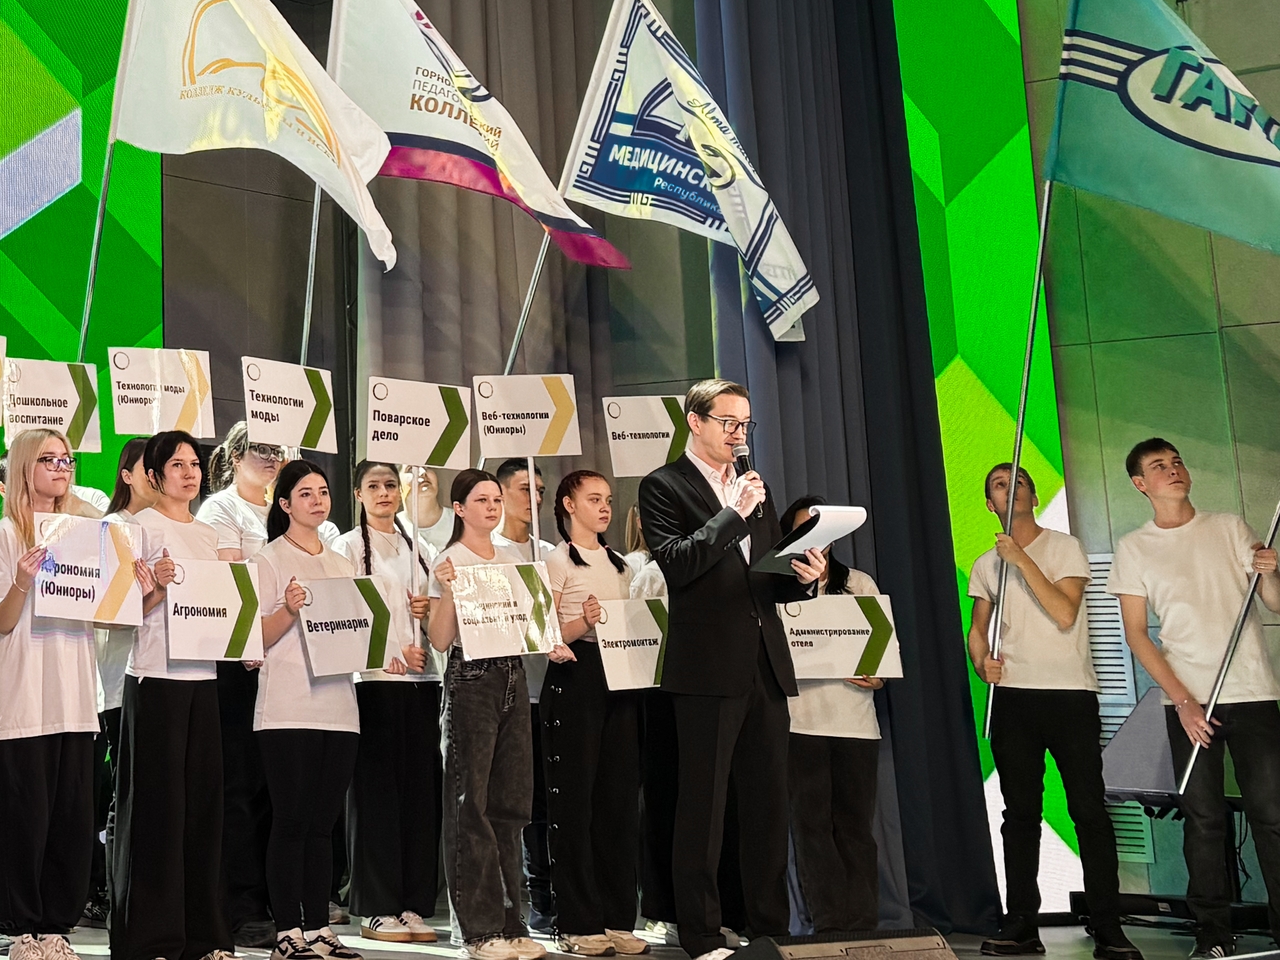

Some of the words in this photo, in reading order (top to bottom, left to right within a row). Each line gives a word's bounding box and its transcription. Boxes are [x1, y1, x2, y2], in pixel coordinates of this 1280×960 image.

[687, 98, 730, 134] Alma
[164, 385, 185, 394] моды
[8, 394, 68, 408] Дошкольное
[249, 389, 304, 408] Технологии
[9, 413, 64, 426] воспитание
[251, 410, 280, 423] моды
[372, 409, 431, 427] Поварское
[482, 411, 549, 421] Веб-технологии
[372, 429, 399, 442] дело
[483, 423, 526, 436] (Юниоры)
[612, 431, 670, 441] Веб-технологии
[40, 581, 95, 603] (Юниоры)
[173, 603, 227, 619] Агрономия
[510, 613, 528, 624] уход
[306, 618, 370, 635] Ветеринария
[789, 627, 870, 638] Администрирование
[601, 637, 659, 651] Электромонтаж
